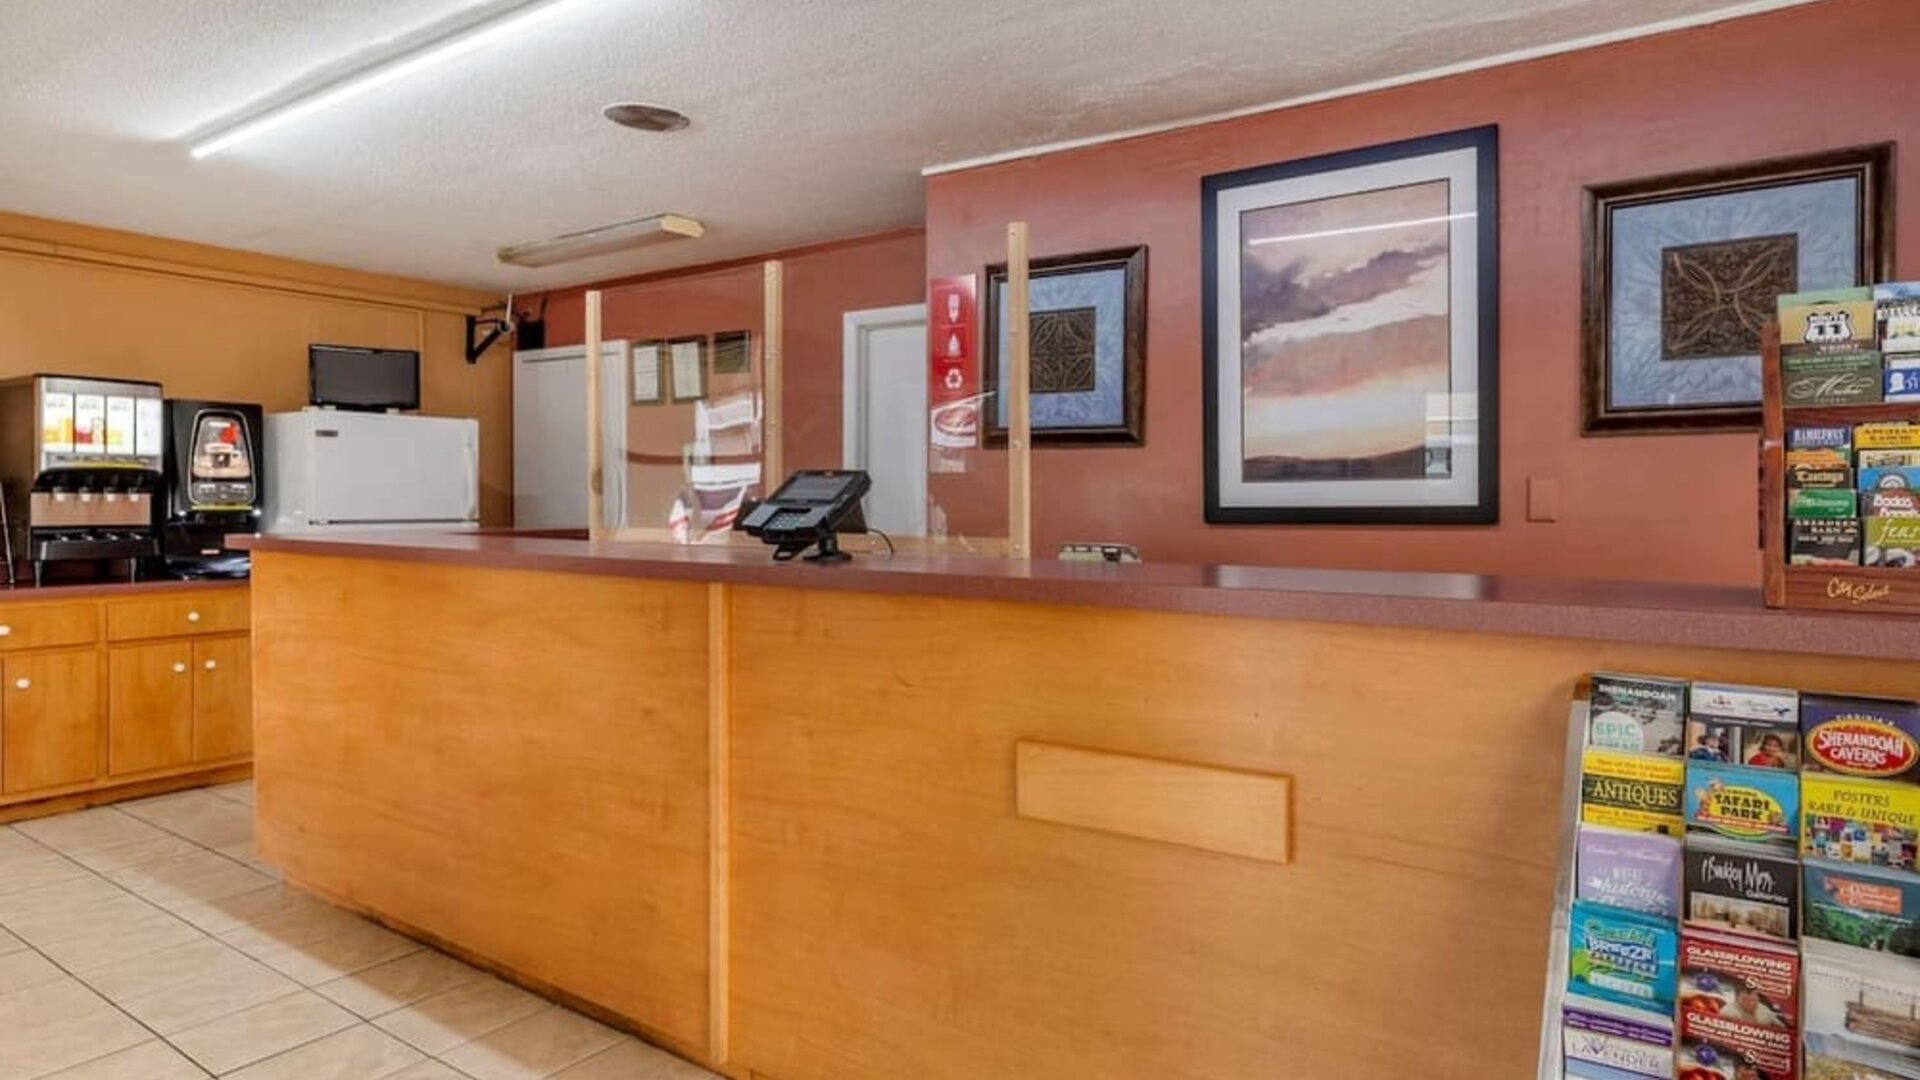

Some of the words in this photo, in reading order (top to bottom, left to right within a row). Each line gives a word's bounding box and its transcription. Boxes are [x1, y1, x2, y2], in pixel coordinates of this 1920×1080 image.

[1814, 324, 1841, 336] 11
[1598, 684, 1676, 700] SHENANDOAH
[1595, 722, 1637, 736] EPIC
[1817, 729, 1904, 760] SHENANDOAH
[1830, 746, 1887, 765] CAVERNS
[1592, 779, 1679, 809] ANTIQUES
[1721, 806, 1762, 820] PARK
[1687, 946, 1792, 971] GLASSBLOWING
[1687, 1012, 1790, 1043] GLASSBLOWING
